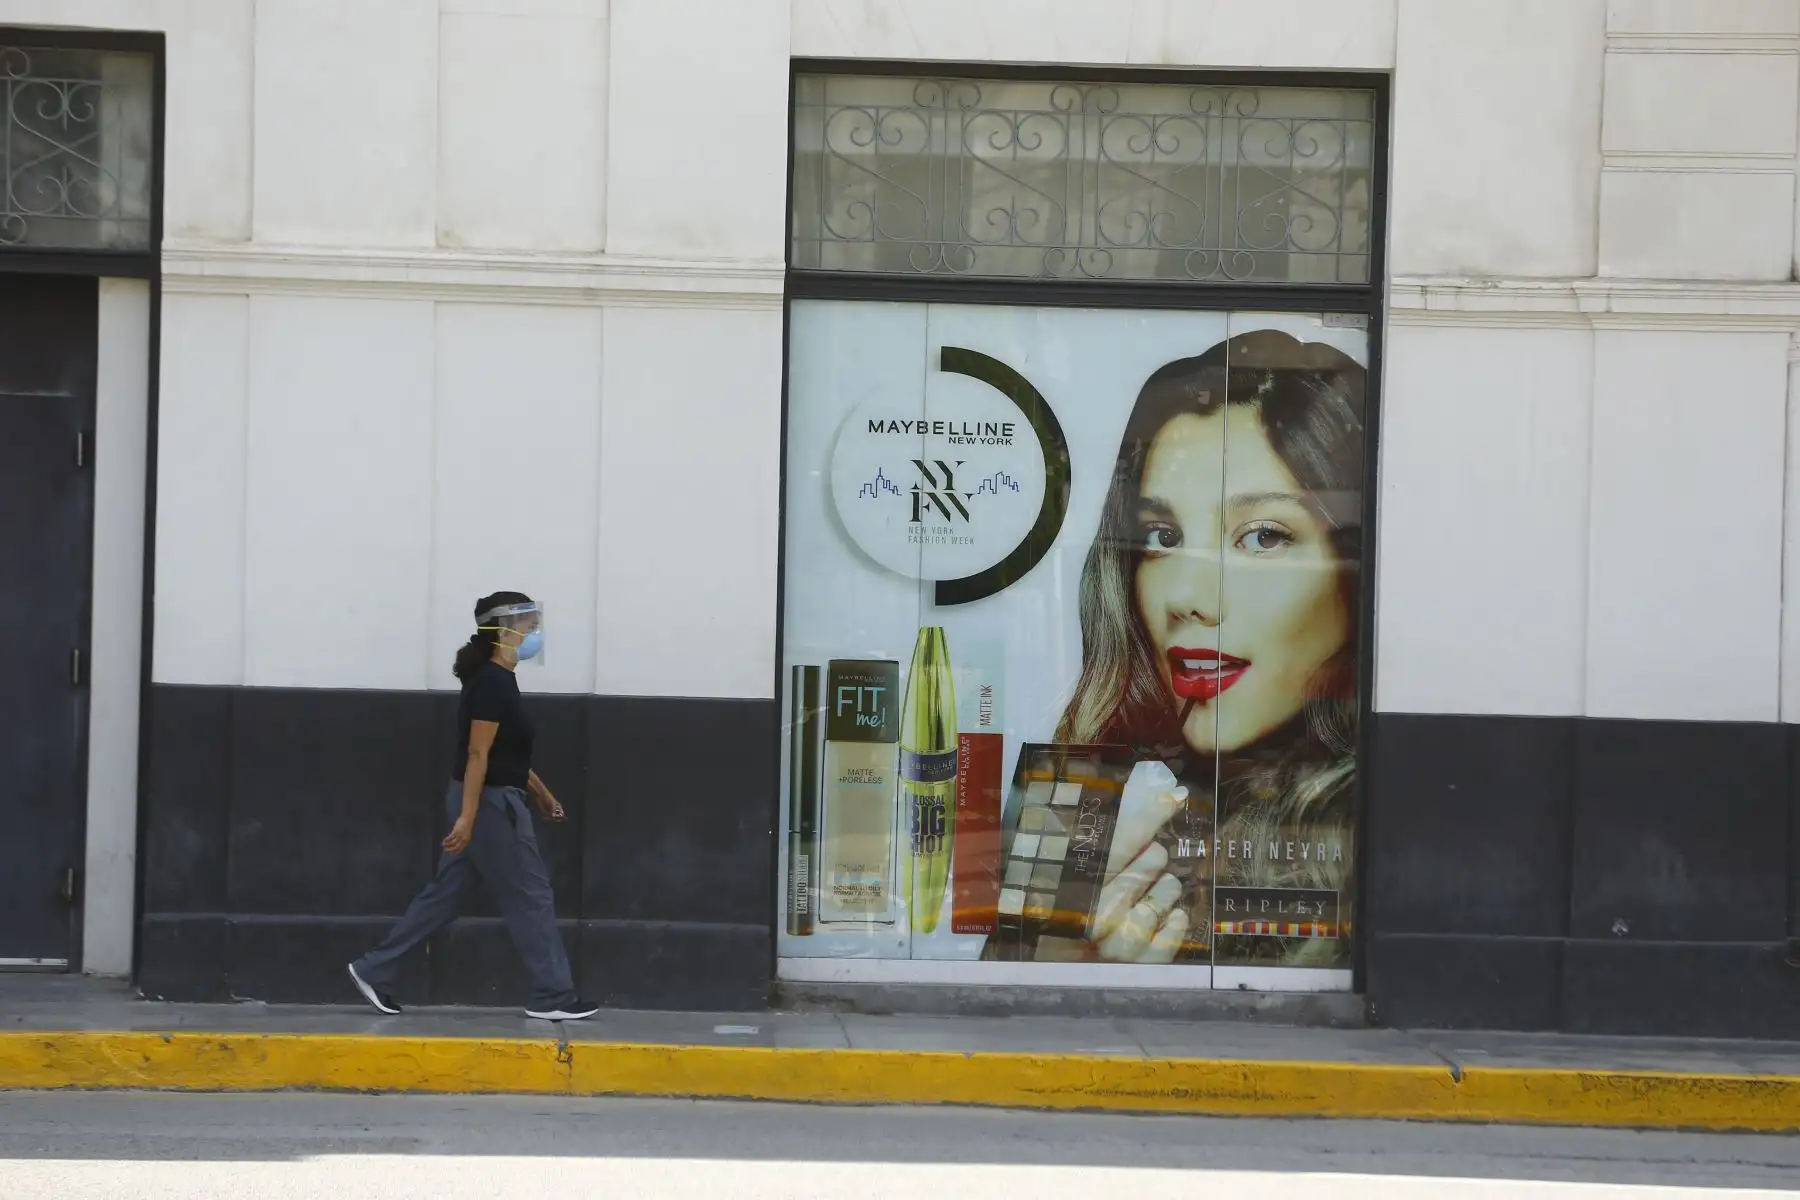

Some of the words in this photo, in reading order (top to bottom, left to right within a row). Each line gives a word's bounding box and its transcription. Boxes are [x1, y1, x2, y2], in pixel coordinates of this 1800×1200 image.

[868, 419, 1015, 437] MAYBELLINE
[948, 437, 977, 445] NEW
[979, 437, 1013, 446] YORK
[908, 526, 926, 535] NEW
[931, 526, 955, 535] YORK
[908, 535, 947, 545] FASHION
[951, 536, 975, 545] WEEK
[837, 686, 887, 717] FIT
[856, 707, 886, 728] me!
[847, 768, 874, 776] MATTE
[959, 738, 967, 807] MAYBELLINE
[1178, 838, 1252, 859] MAFER
[1269, 841, 1343, 862] NEYRA
[1225, 898, 1326, 916] RIPLEY
